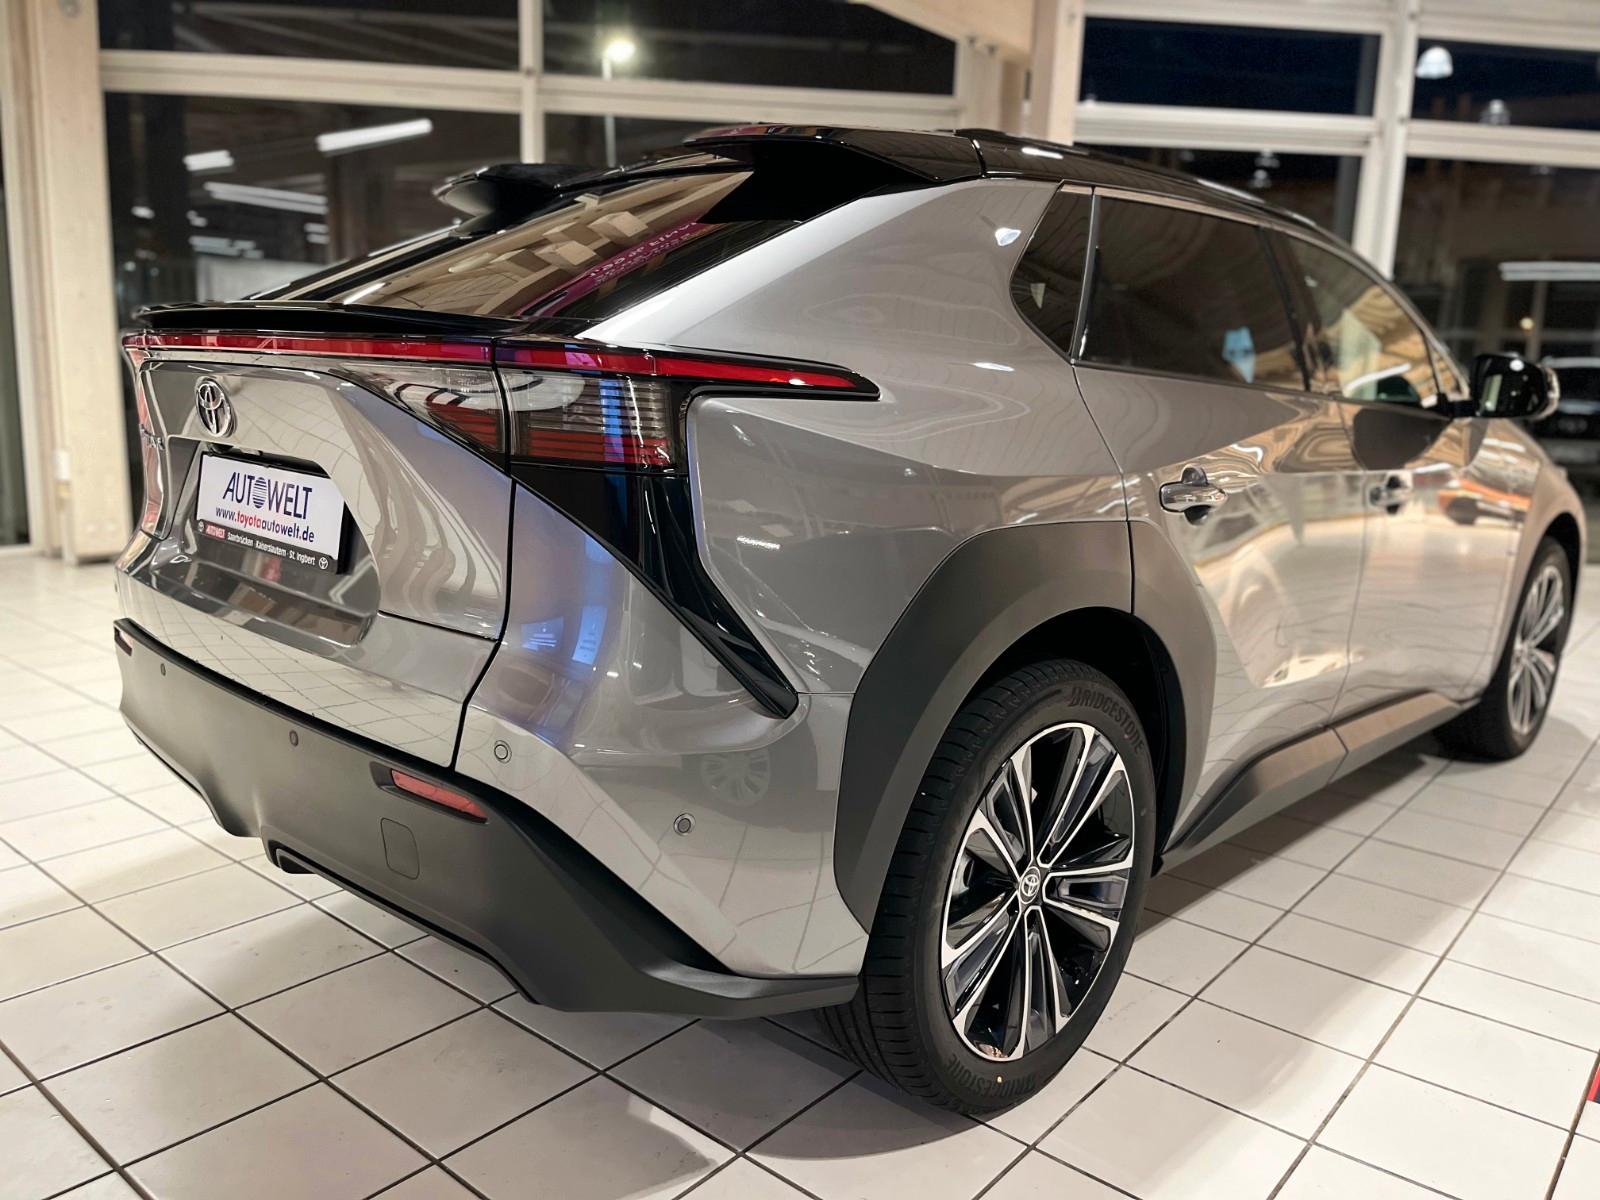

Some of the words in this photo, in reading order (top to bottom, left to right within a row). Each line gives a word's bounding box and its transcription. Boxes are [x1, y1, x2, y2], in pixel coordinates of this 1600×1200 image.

[223, 472, 312, 519] AUTOWELT
[216, 506, 315, 543] www.toyotaautowelt.de
[256, 540, 287, 557] Kaiserslautern
[297, 552, 316, 566] Ingbert
[1068, 686, 1144, 754] BRIDGESTONE
